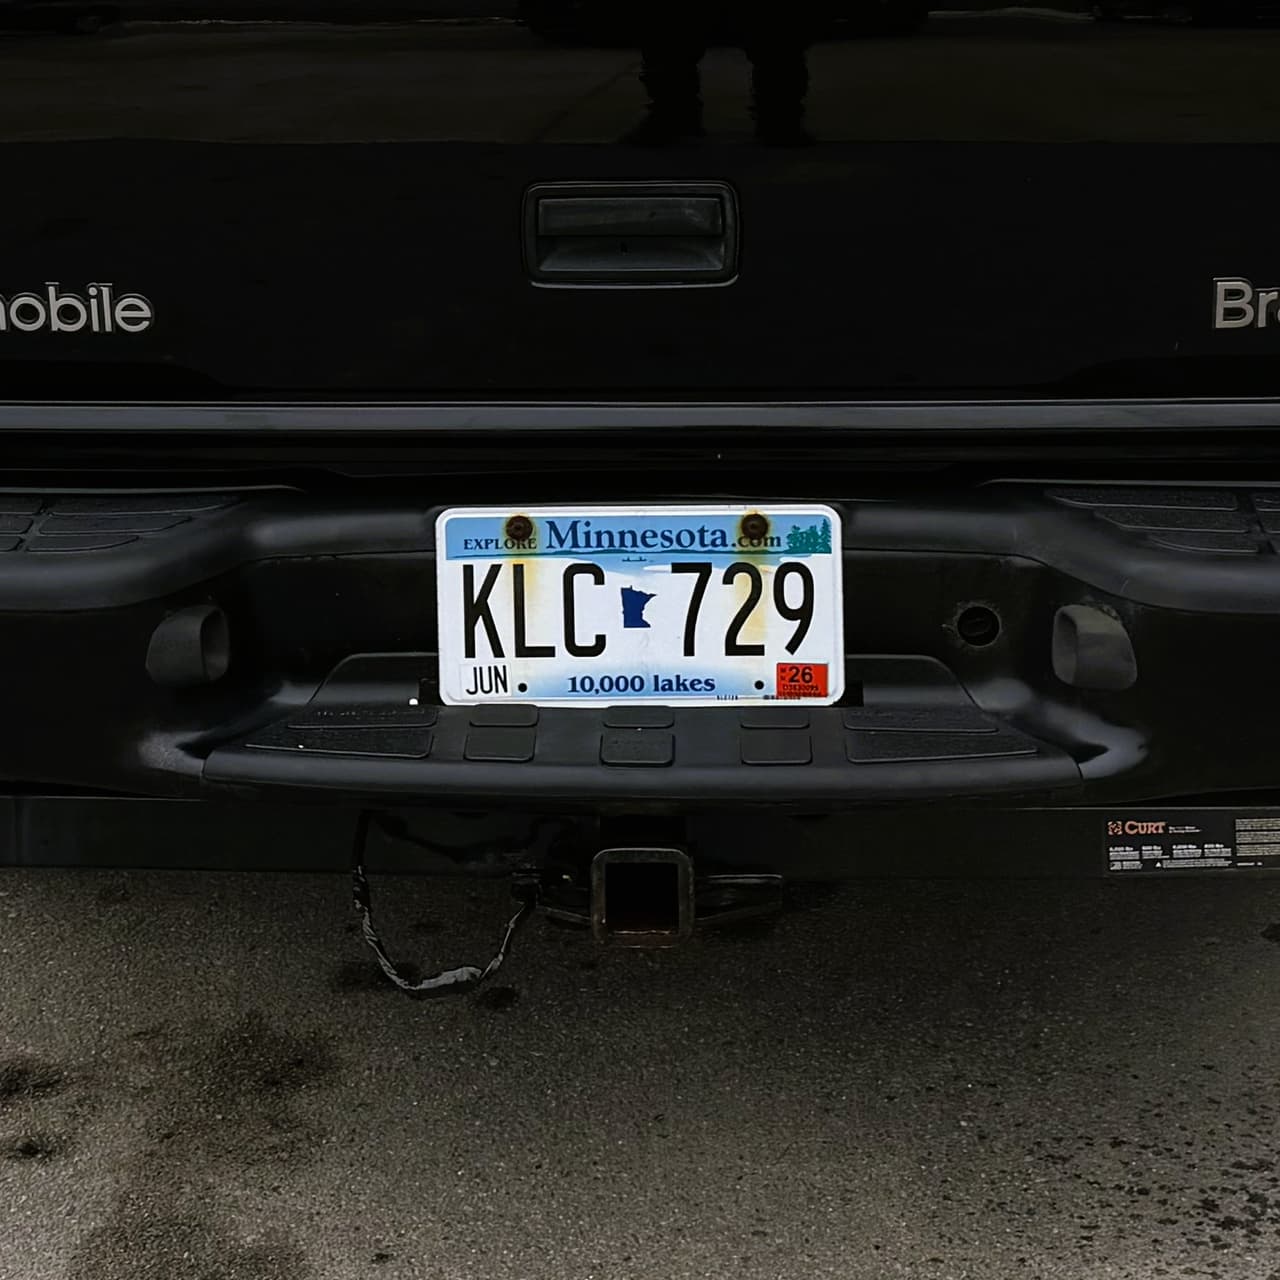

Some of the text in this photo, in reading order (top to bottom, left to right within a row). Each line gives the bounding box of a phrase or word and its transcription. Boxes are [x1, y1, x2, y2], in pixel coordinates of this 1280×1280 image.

[463, 561, 814, 658] KLC 729
[465, 665, 508, 695] JUN
[567, 674, 716, 695] 10,000 lakes
[788, 665, 813, 684] 26
